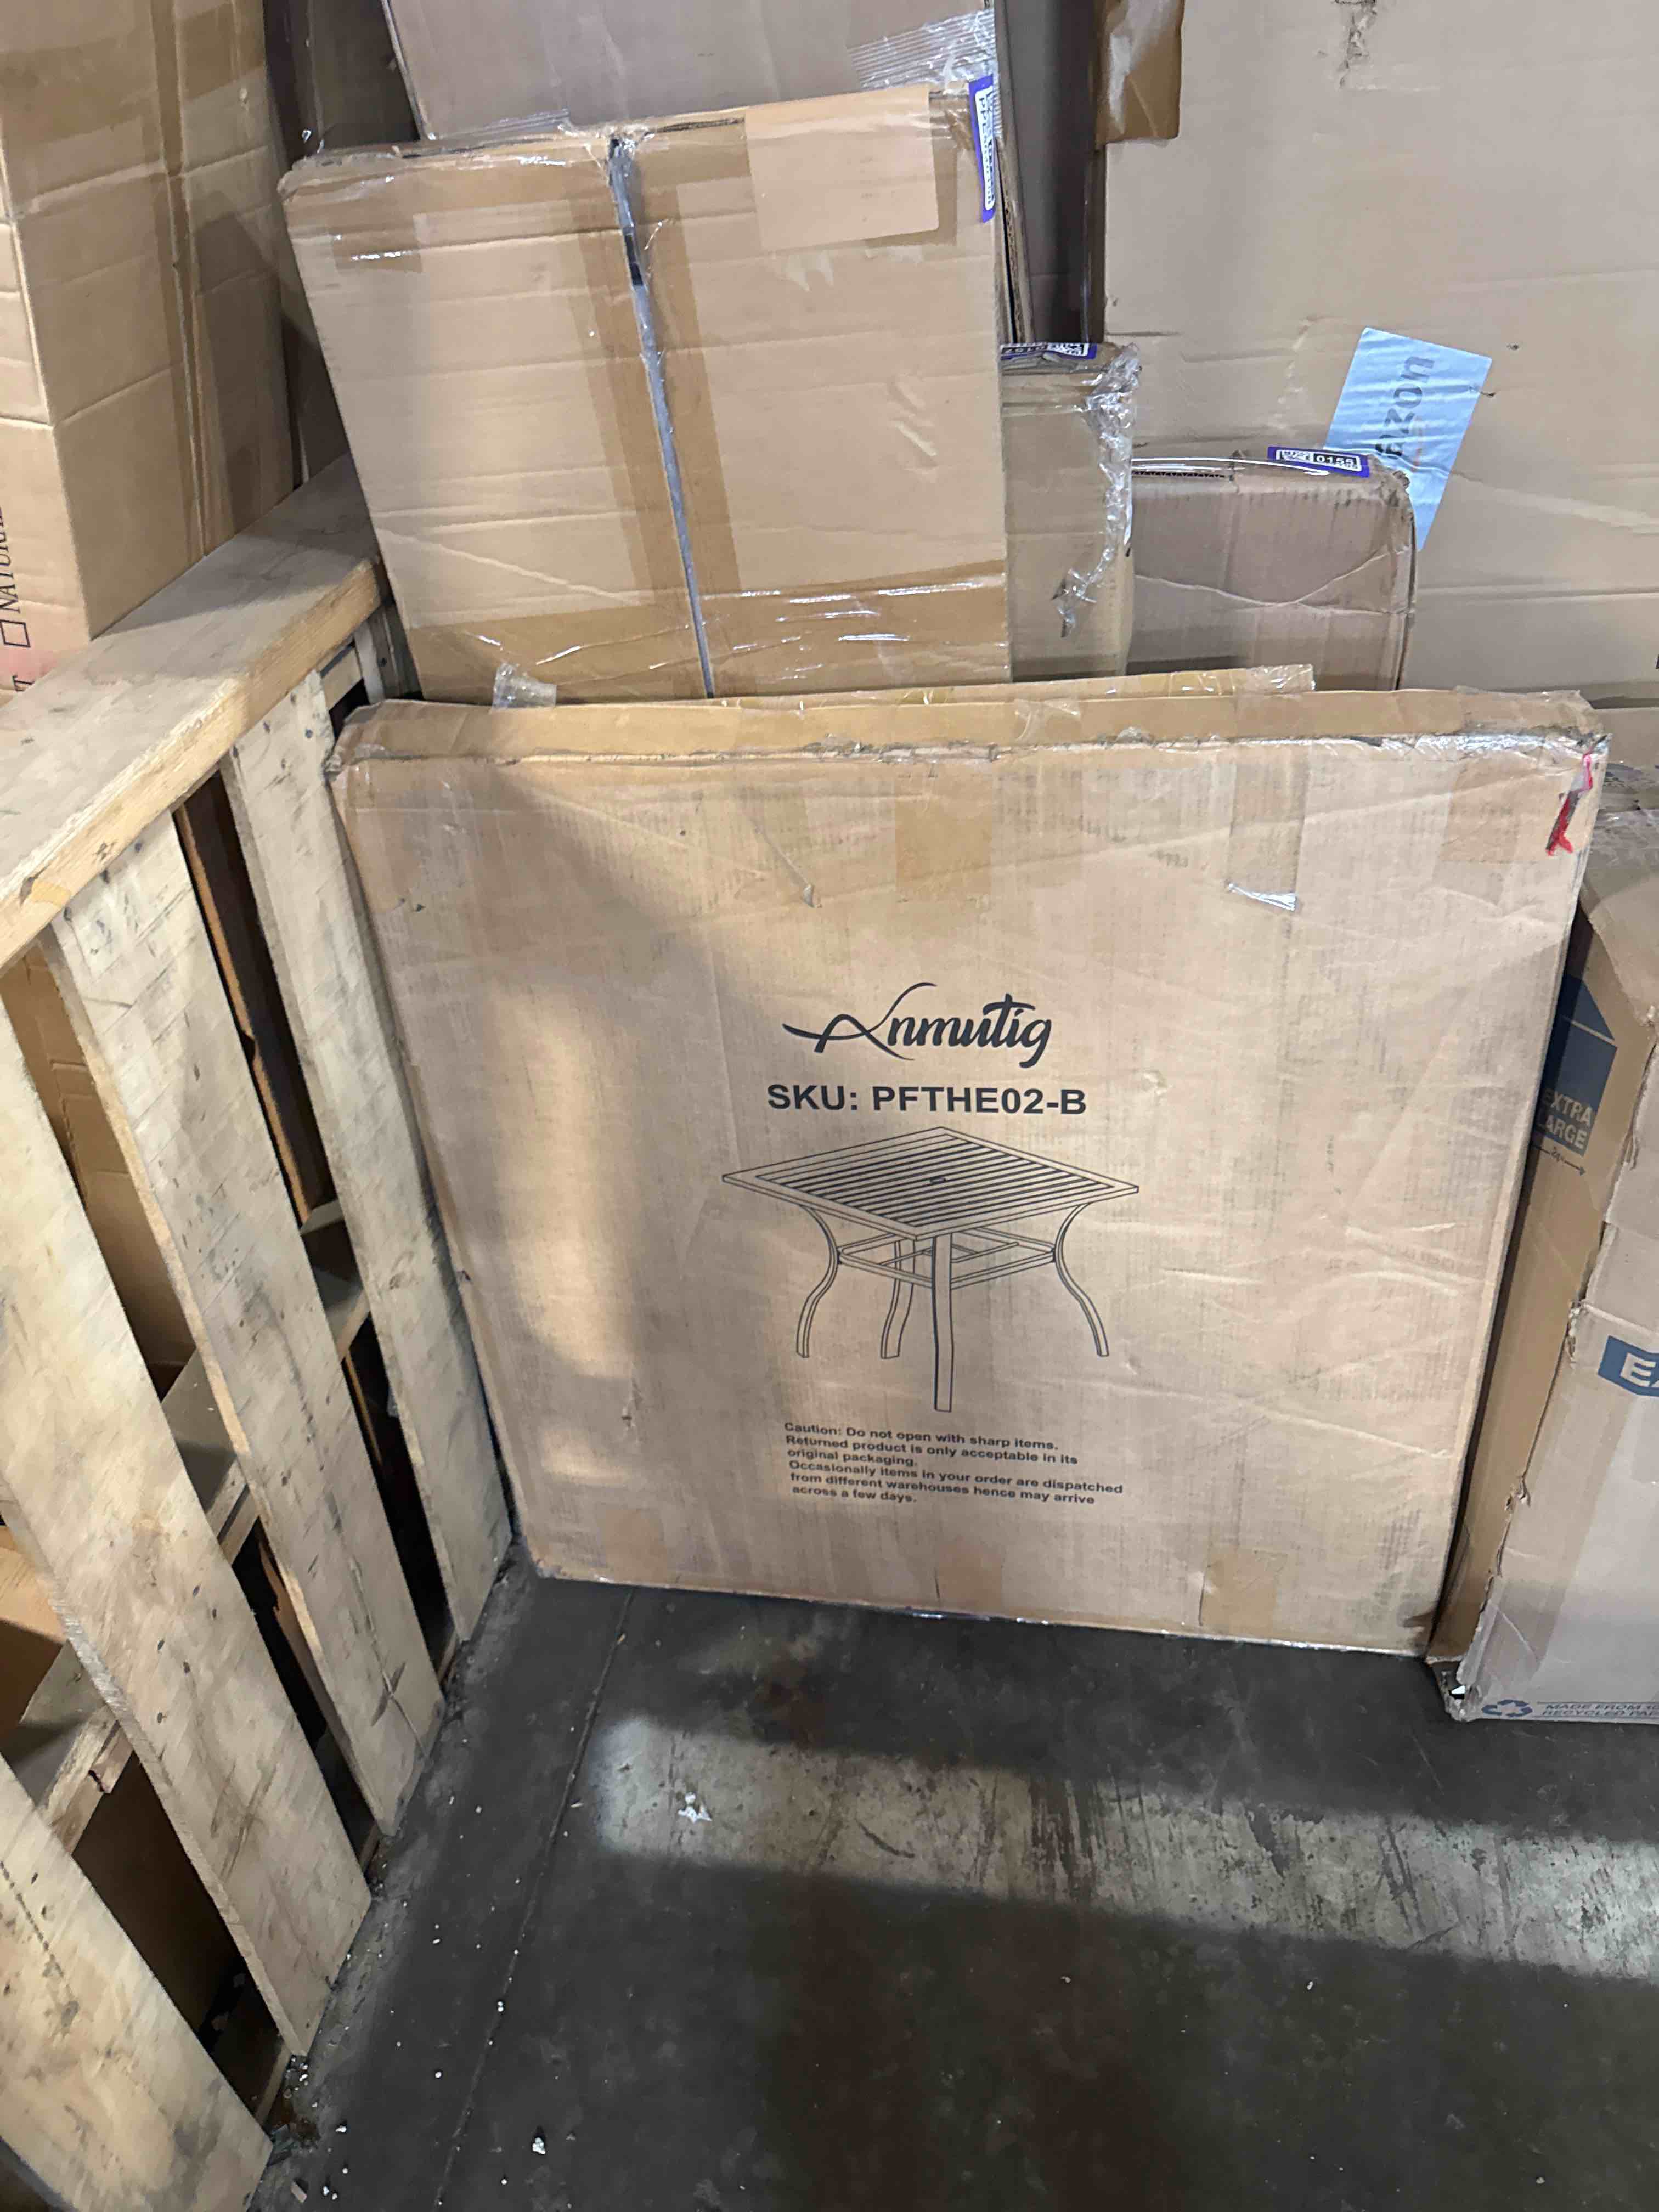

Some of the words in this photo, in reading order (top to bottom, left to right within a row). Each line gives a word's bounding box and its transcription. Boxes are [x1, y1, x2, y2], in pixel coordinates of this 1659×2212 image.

[1316, 455, 1354, 465] 0155
[782, 981, 1052, 1069] Anmutig
[768, 1084, 858, 1111] SKU:
[873, 1086, 1086, 1115] PFTHE02-B
[785, 1422, 842, 1435] Caution:
[847, 1427, 865, 1437] Do
[870, 1430, 893, 1439] not
[896, 1432, 931, 1442] open
[935, 1434, 965, 1443] with
[969, 1436, 1010, 1448] sharp
[1015, 1438, 1058, 1450] items.
[786, 1436, 848, 1448] Returned
[853, 1442, 906, 1452] product
[927, 1446, 957, 1458] only
[961, 1449, 1038, 1462] acceptable
[1043, 1453, 1056, 1463] in
[1060, 1454, 1078, 1465] its
[788, 1449, 838, 1460] original
[843, 1454, 917, 1467] packaging.
[789, 1460, 876, 1476] Occasionally
[880, 1467, 918, 1478] items
[922, 1470, 935, 1479] in
[939, 1472, 970, 1482] your
[975, 1475, 1012, 1485] order
[1017, 1478, 1039, 1487] are
[1042, 1477, 1124, 1494] dispatched
[790, 1473, 822, 1482] from
[826, 1475, 883, 1488] different
[886, 1481, 970, 1494] warehouses
[974, 1486, 1015, 1498] hence
[1020, 1491, 1049, 1502] may
[1054, 1493, 1095, 1504] arrive
[792, 1486, 837, 1497] across
[853, 1489, 876, 1499] few
[880, 1492, 917, 1503] days.
